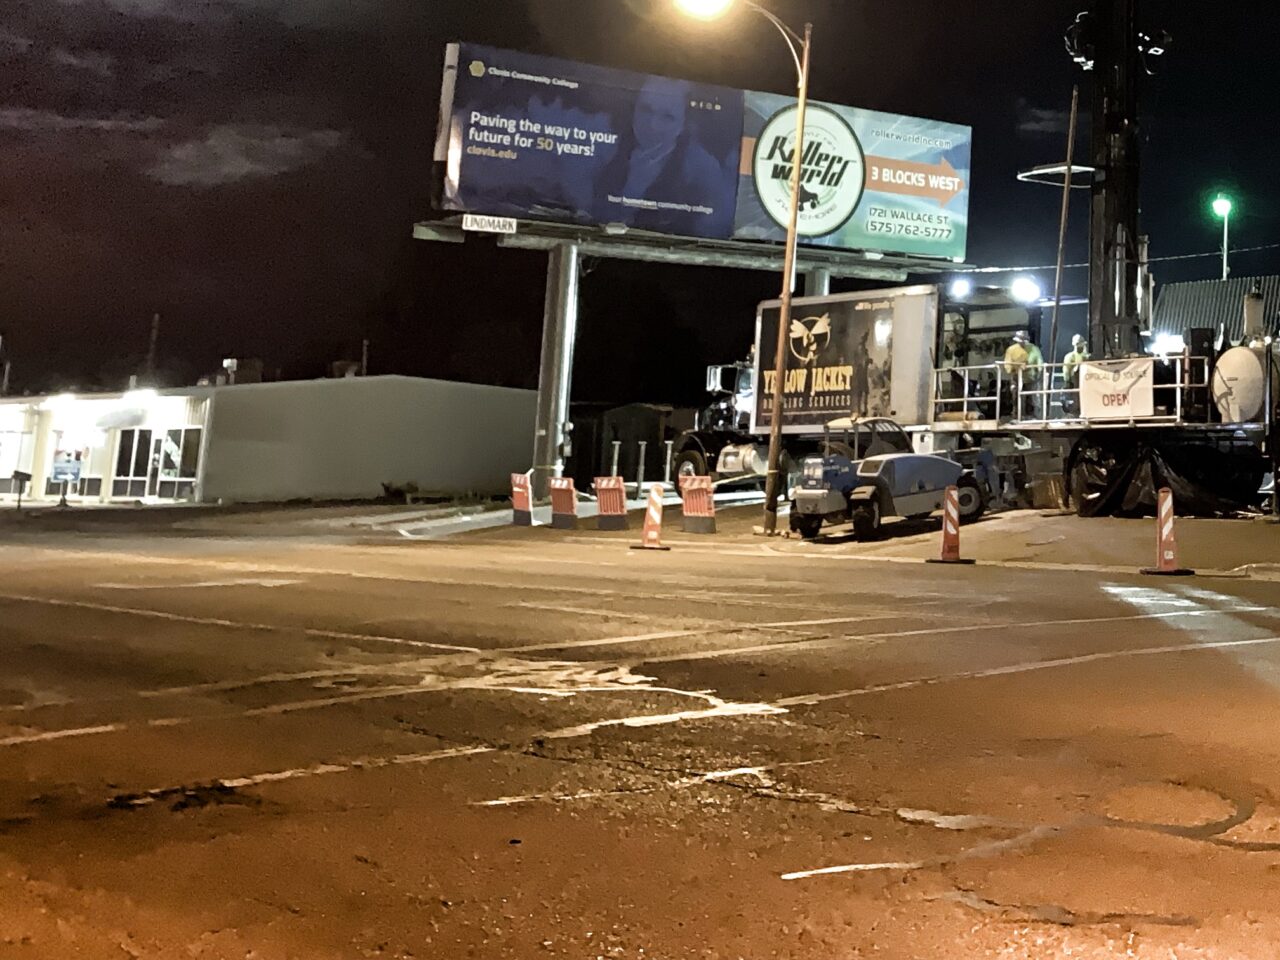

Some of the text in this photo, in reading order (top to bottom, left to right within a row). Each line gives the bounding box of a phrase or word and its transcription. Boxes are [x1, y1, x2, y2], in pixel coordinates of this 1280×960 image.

[488, 66, 579, 89] Clovis Community College
[470, 111, 618, 145] Paving the way to your
[469, 127, 596, 157] future for 50 years!
[466, 144, 518, 160] clovis.edu
[871, 166, 961, 191] 3 BLOCKS WEST
[464, 216, 515, 231] LINDMARK
[869, 207, 887, 217] 1721
[890, 209, 934, 223] WALLACE
[763, 365, 854, 396] YELOW JACKET
[763, 395, 852, 410] DRLING SERVICES
[1102, 393, 1130, 407] OPEN
